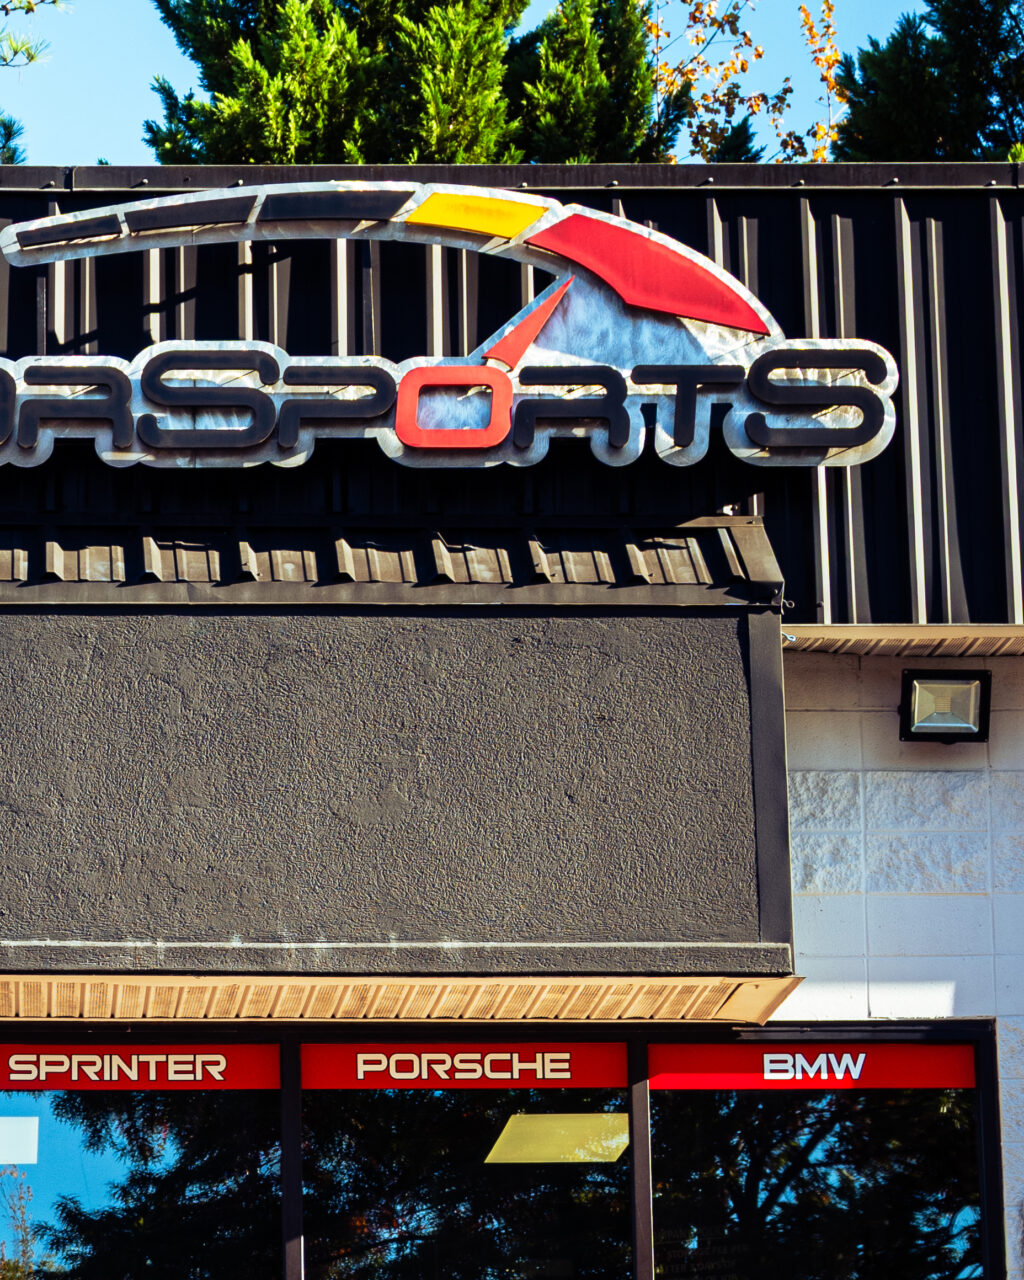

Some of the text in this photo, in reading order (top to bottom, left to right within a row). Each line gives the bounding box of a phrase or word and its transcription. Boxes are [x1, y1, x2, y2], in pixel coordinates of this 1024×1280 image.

[8, 1053, 228, 1081] SPRINTER
[356, 1052, 572, 1080] PORSCHE
[762, 1052, 867, 1080] BMW
